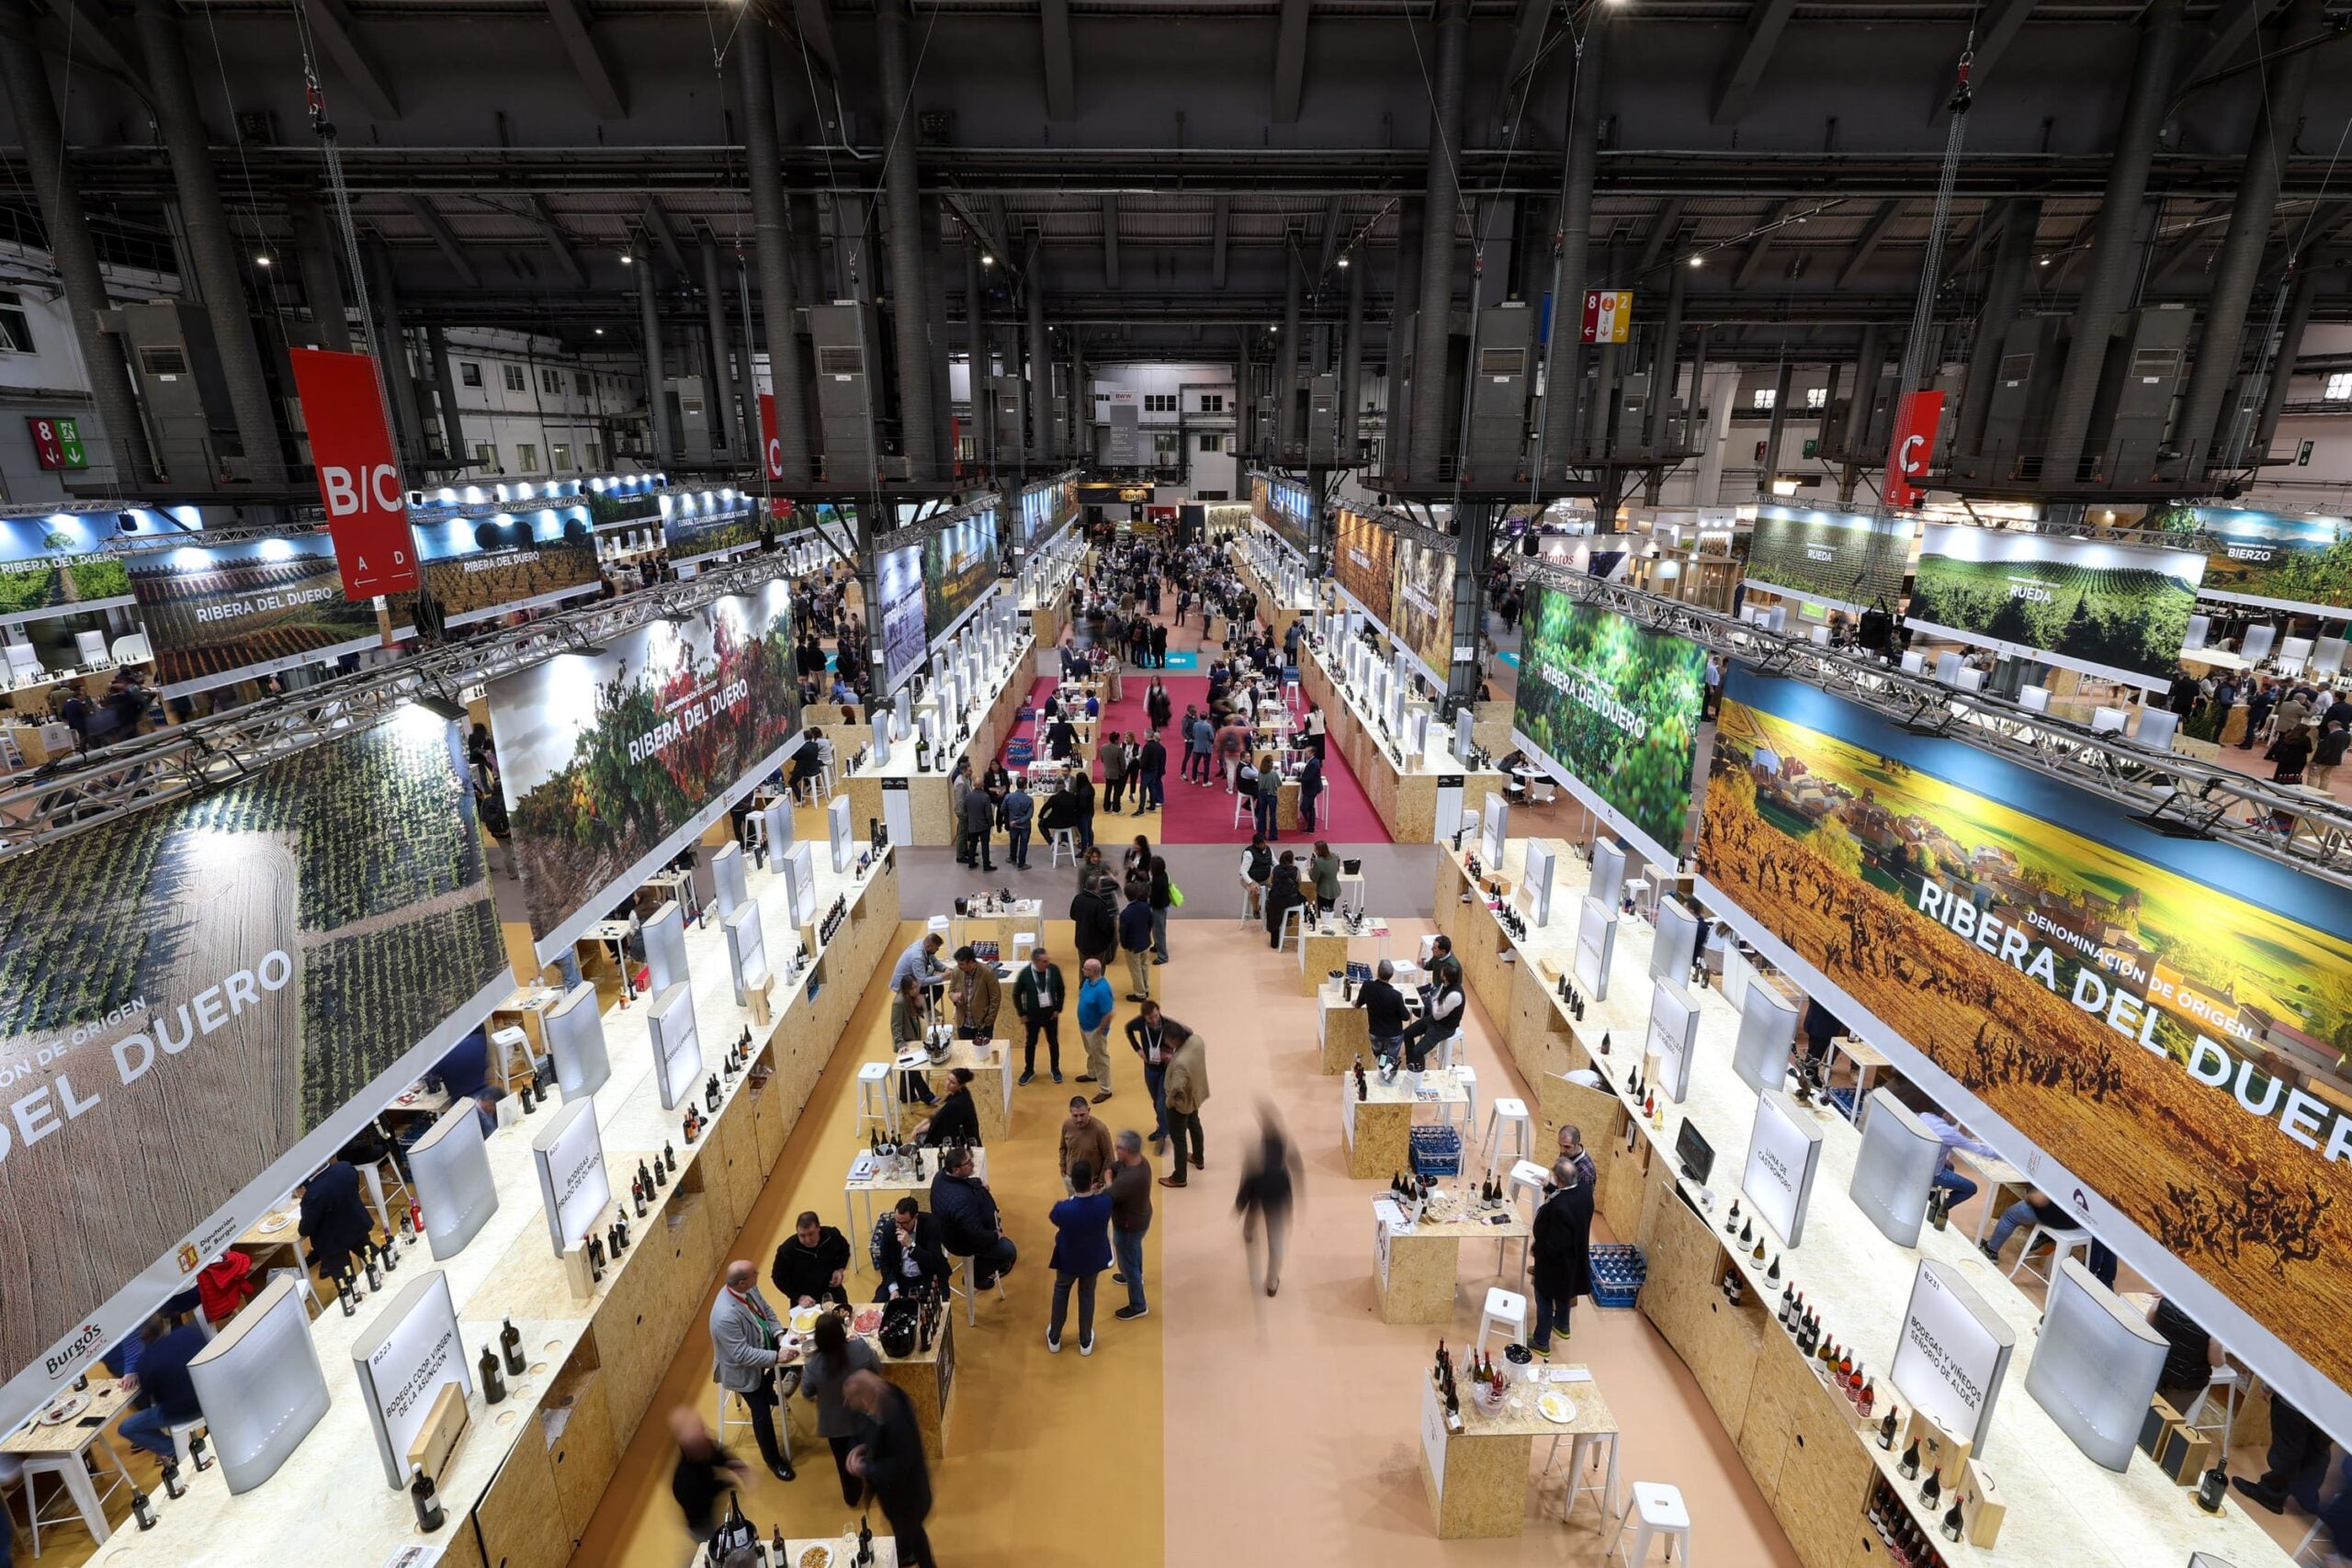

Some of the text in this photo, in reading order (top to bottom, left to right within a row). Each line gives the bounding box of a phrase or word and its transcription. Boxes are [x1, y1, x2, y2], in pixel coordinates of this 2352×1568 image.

[1589, 296, 1597, 310] 8
[1620, 296, 1628, 309] 2
[39, 422, 52, 441] 8
[1899, 434, 1925, 472] C
[322, 464, 402, 516] B/C
[2, 561, 49, 575] RIBERA
[52, 556, 77, 569] DEL
[358, 557, 368, 571] A
[394, 551, 404, 565] D
[464, 558, 495, 573] RIBERA
[497, 556, 512, 568] DEL
[513, 551, 540, 565] DUERO
[1807, 549, 1832, 562] RUEDA
[2227, 547, 2271, 561] BIERZO
[196, 586, 333, 623] RIBERA DEL DUERO
[2010, 584, 2051, 604] RUEDA
[1543, 662, 1577, 697] RIBERA
[1578, 686, 1599, 712] DEL
[1601, 696, 1645, 739] DUERO
[628, 678, 748, 765] RIBERA DEL DUERO
[1918, 879, 2056, 991] RIBERA
[2071, 967, 2168, 1058] DEL
[2027, 910, 2253, 1043] DENOMINACIÓN DE ORIGEN
[36, 1039, 68, 1066] DE
[72, 995, 147, 1045] ORIGEN
[0, 950, 291, 1163] EL DUERO
[567, 1156, 589, 1187] BODEGAS
[1758, 1151, 1792, 1192] CASTROMORO
[1765, 1147, 1787, 1176] LUNA DE
[558, 1152, 600, 1211] PRADO DE OLMEDO
[199, 1216, 234, 1247] Diputación
[203, 1224, 236, 1254] de Burgos
[1924, 1270, 1939, 1291] B231
[46, 1324, 101, 1374] Burgos
[373, 1341, 391, 1365] B223
[1911, 1315, 1982, 1403] BODEGAS Y VIÑEDOS
[386, 1382, 413, 1417] BODEGA
[431, 1330, 452, 1359] VIRGEN
[1939, 1365, 1951, 1382] DE
[1950, 1378, 1975, 1411] ALDEA
[399, 1404, 409, 1417] DE
[408, 1391, 418, 1405] LA
